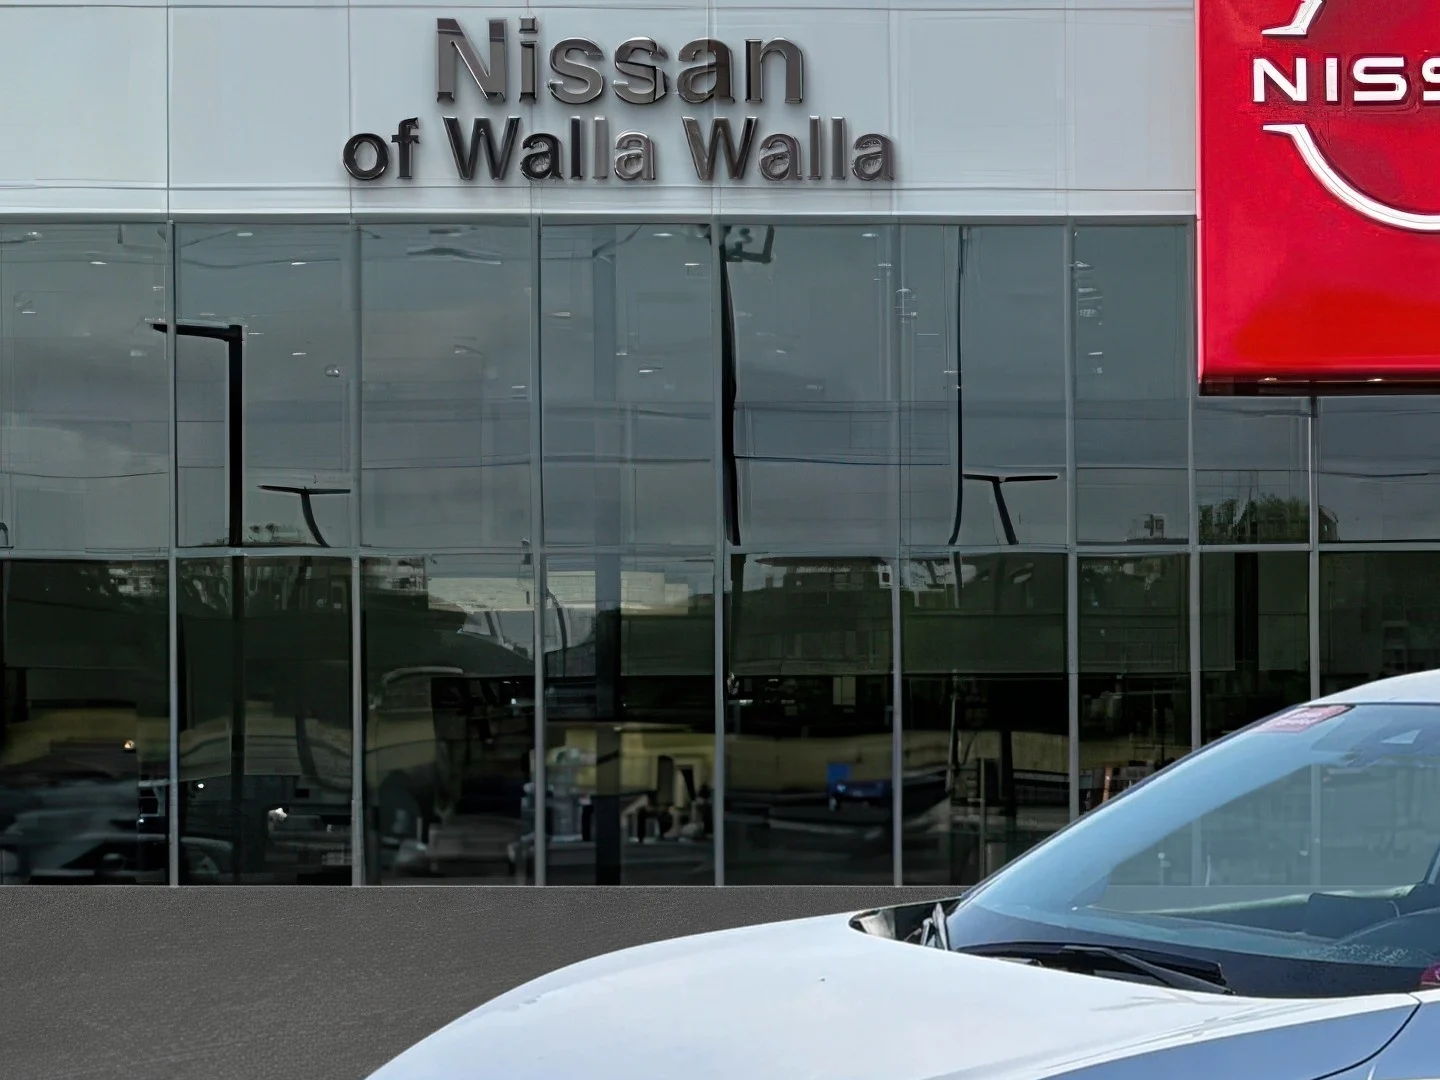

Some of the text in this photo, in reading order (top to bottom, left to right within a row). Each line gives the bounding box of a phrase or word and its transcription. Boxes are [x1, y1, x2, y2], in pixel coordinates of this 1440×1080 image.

[436, 15, 805, 104] Nissan
[342, 115, 895, 181] of Walla Walla
